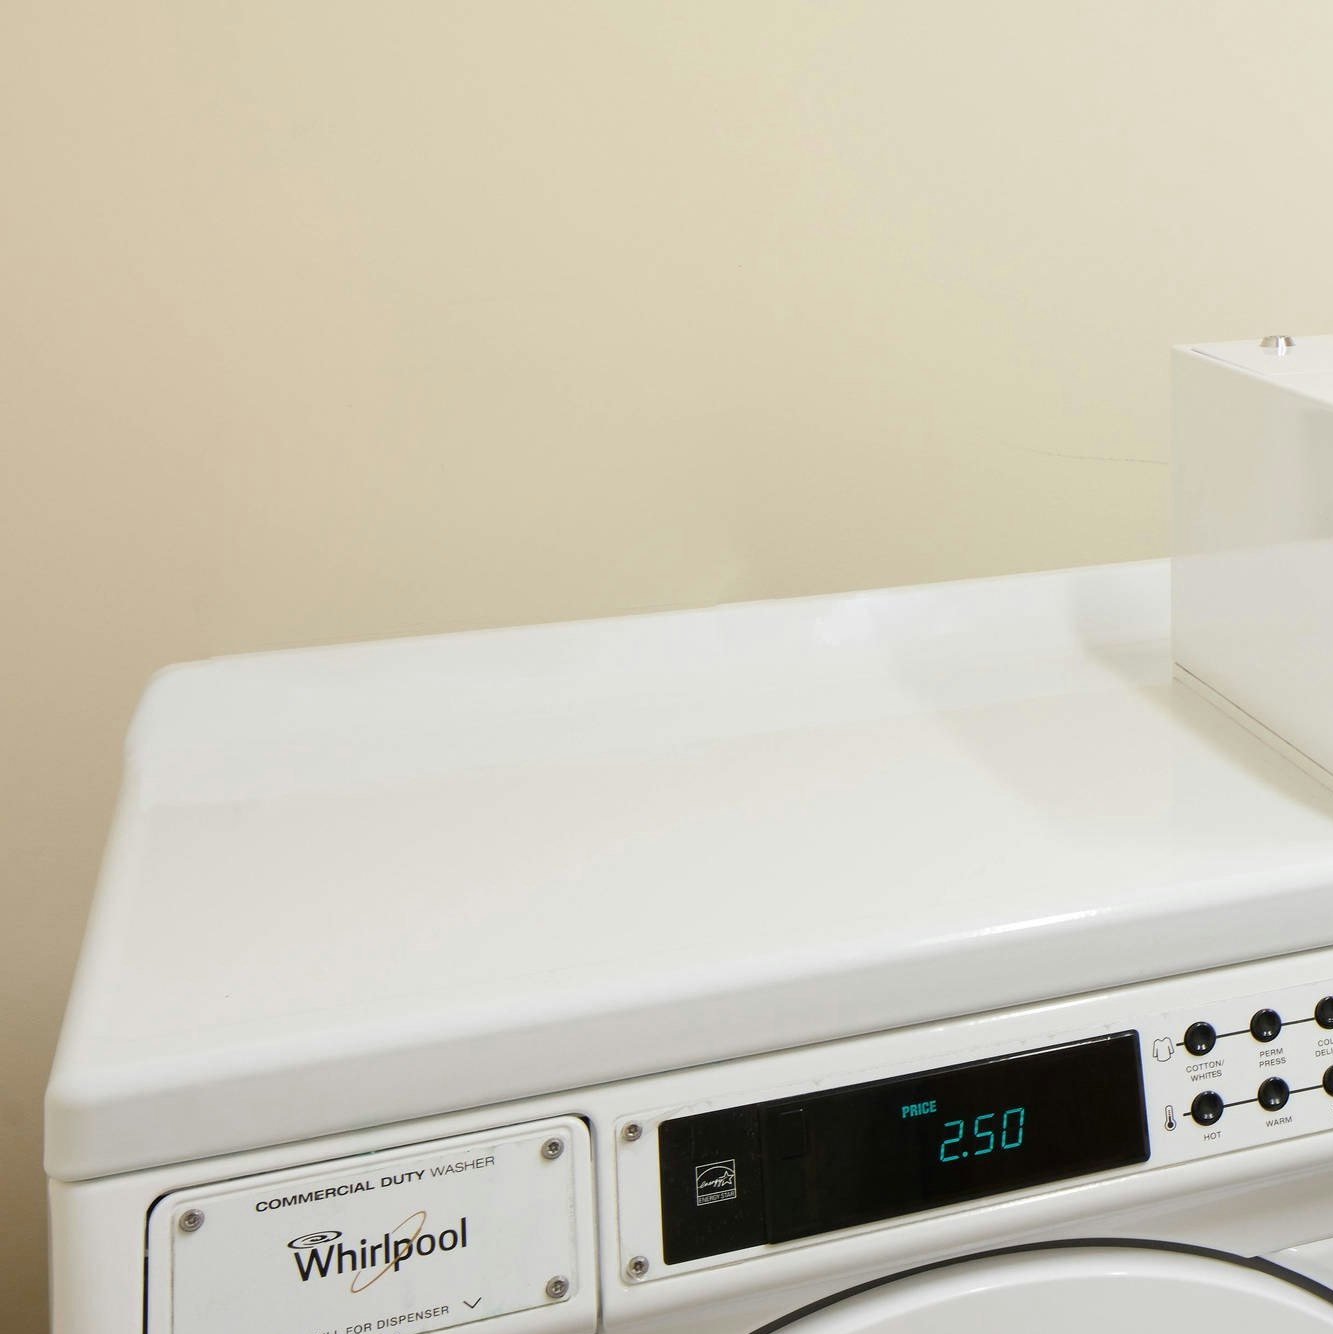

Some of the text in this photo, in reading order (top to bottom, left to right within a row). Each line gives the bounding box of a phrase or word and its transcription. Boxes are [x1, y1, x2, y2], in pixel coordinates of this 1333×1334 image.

[1259, 1048, 1284, 1058] PERM
[1185, 1058, 1225, 1073] COTTON/
[1259, 1057, 1287, 1068] PRESS
[1190, 1070, 1223, 1082] WHITES
[901, 1100, 937, 1119] PRICE
[1265, 1116, 1293, 1128] WARM
[939, 1107, 1025, 1162] 2.50
[1203, 1131, 1222, 1142] HOT
[255, 1155, 496, 1213] COMMERCIAL DUTY WASHER
[293, 1217, 468, 1283] Whirlpool
[376, 1305, 450, 1329] DISPENSER
